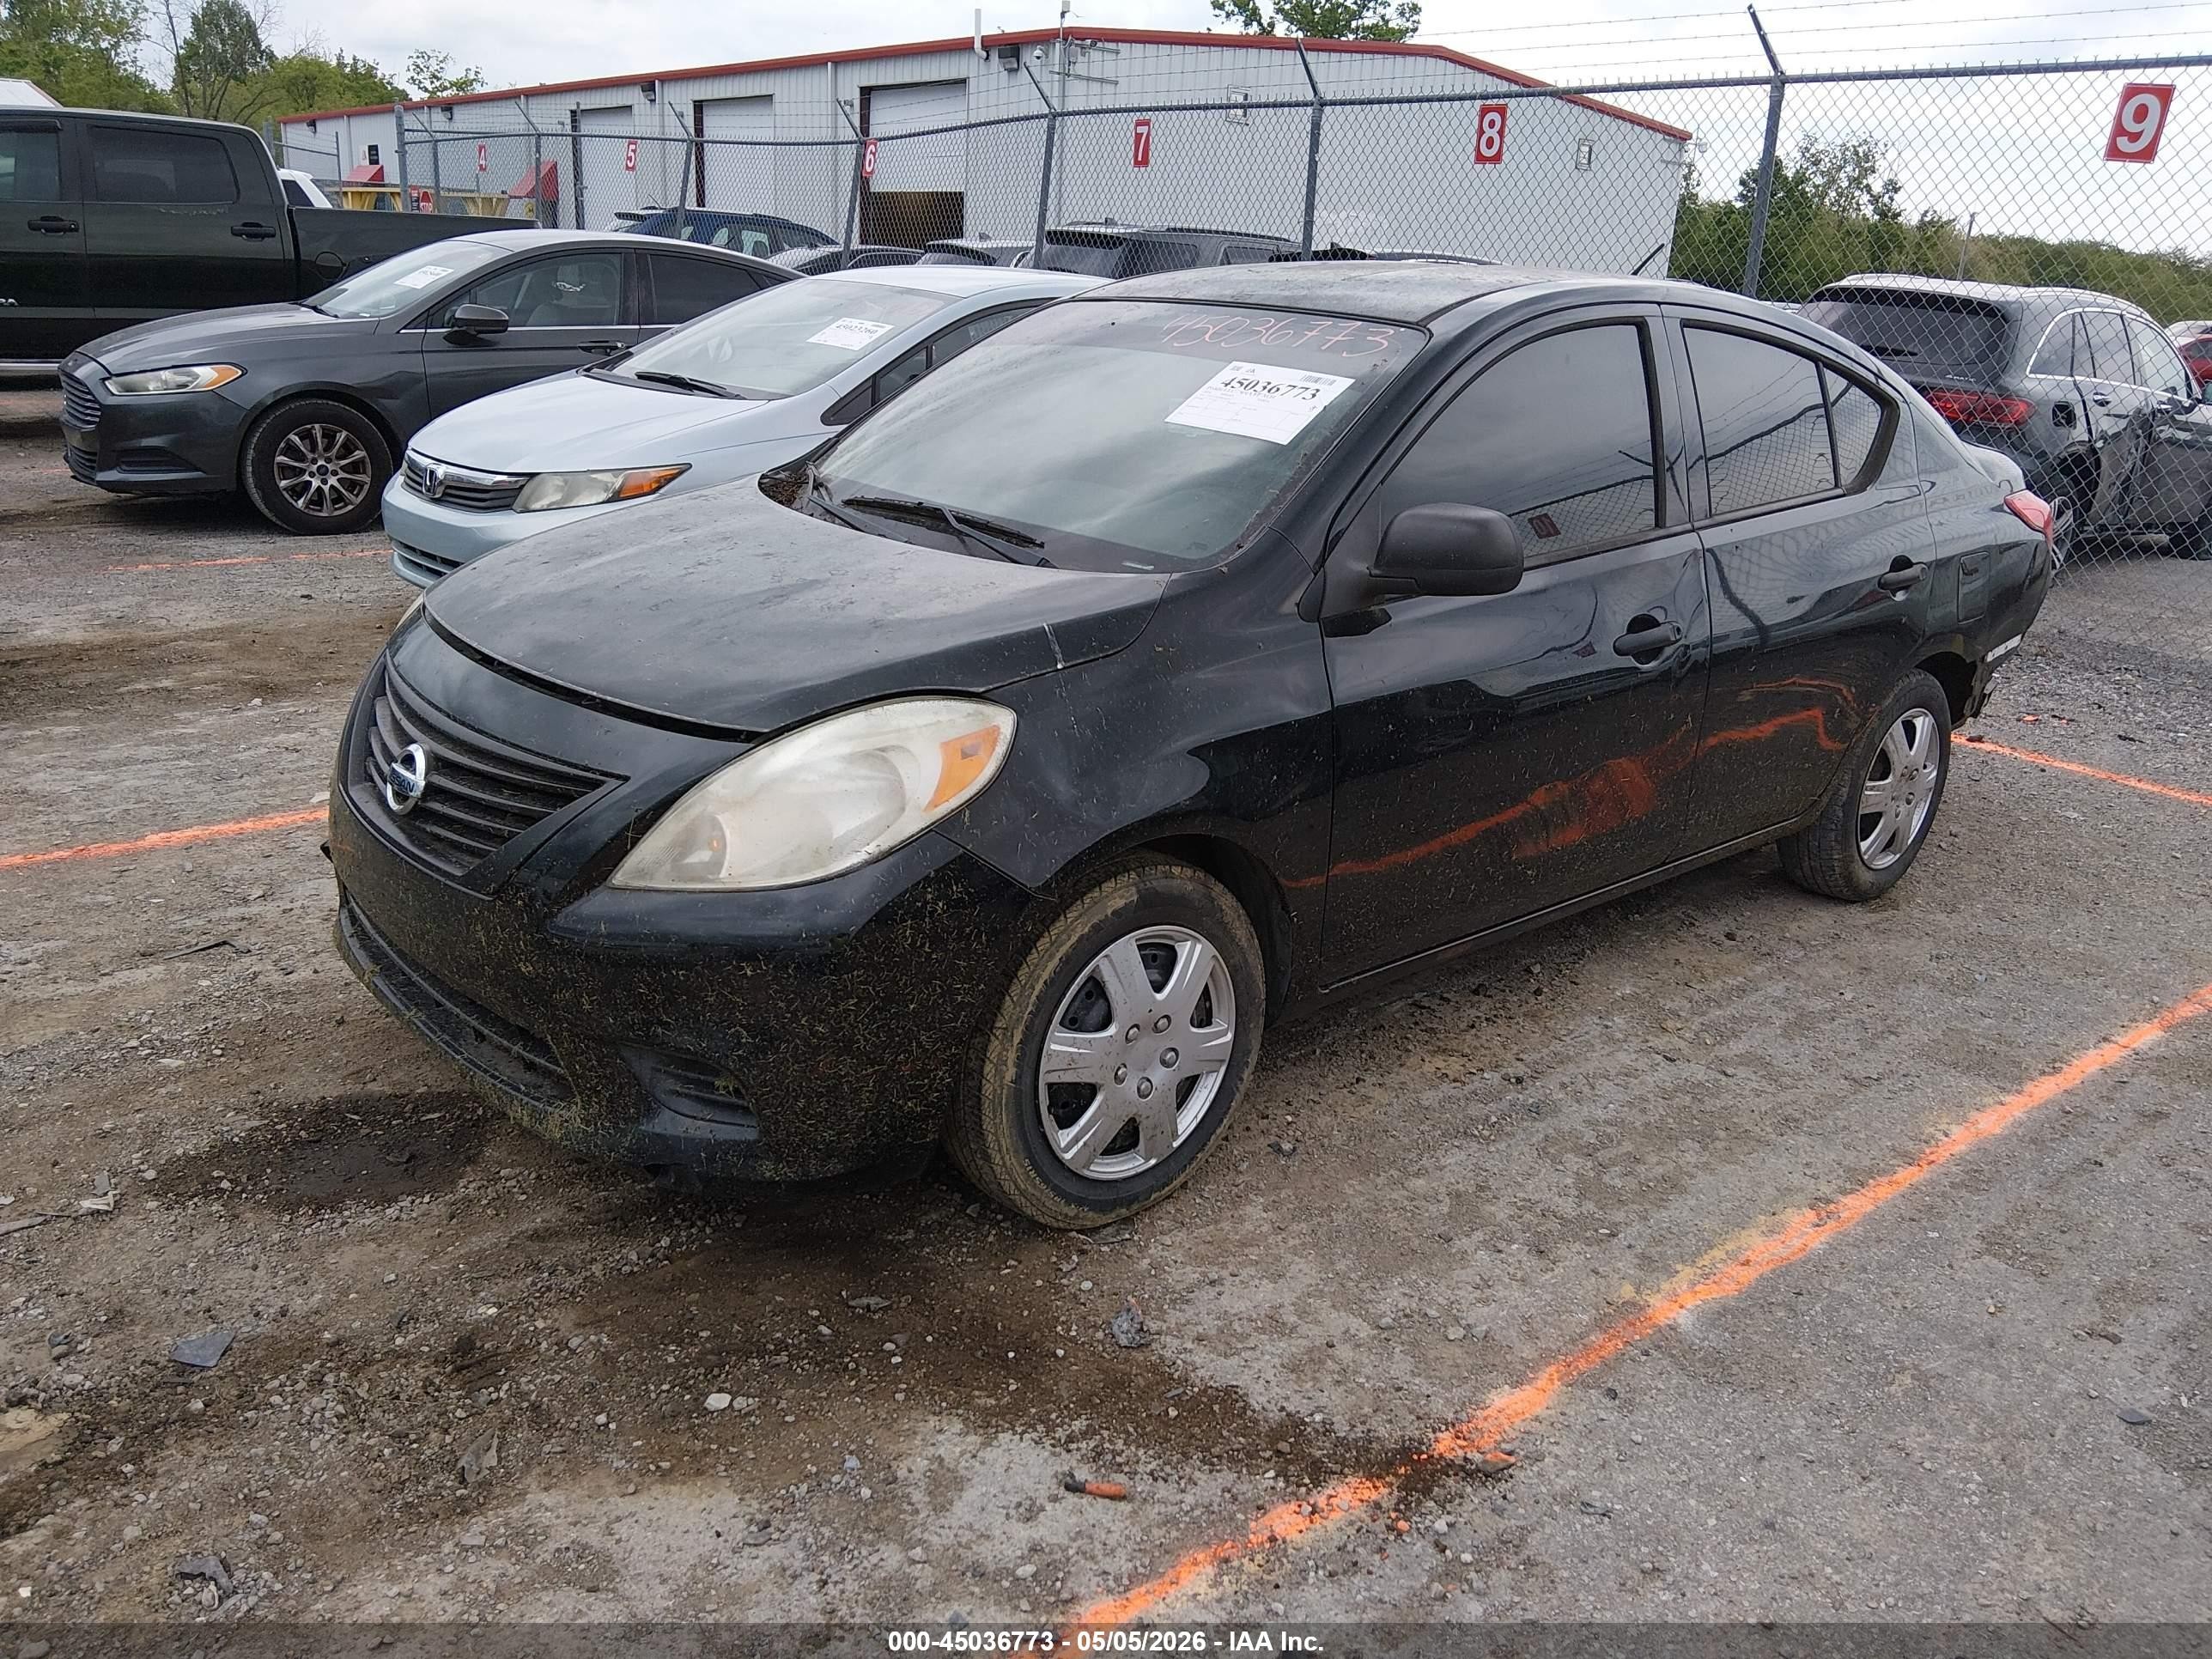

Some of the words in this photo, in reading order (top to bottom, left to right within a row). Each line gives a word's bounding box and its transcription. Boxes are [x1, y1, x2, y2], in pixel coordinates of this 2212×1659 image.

[1480, 111, 1502, 157] 8
[2116, 93, 2161, 153] 9
[479, 147, 486, 168] 4
[627, 144, 635, 167] 5
[1136, 125, 1149, 161] 7
[865, 144, 876, 173] 6
[420, 203, 433, 213] STOP
[1161, 315, 1395, 357] 45036773
[1220, 376, 1321, 401] 45036773
